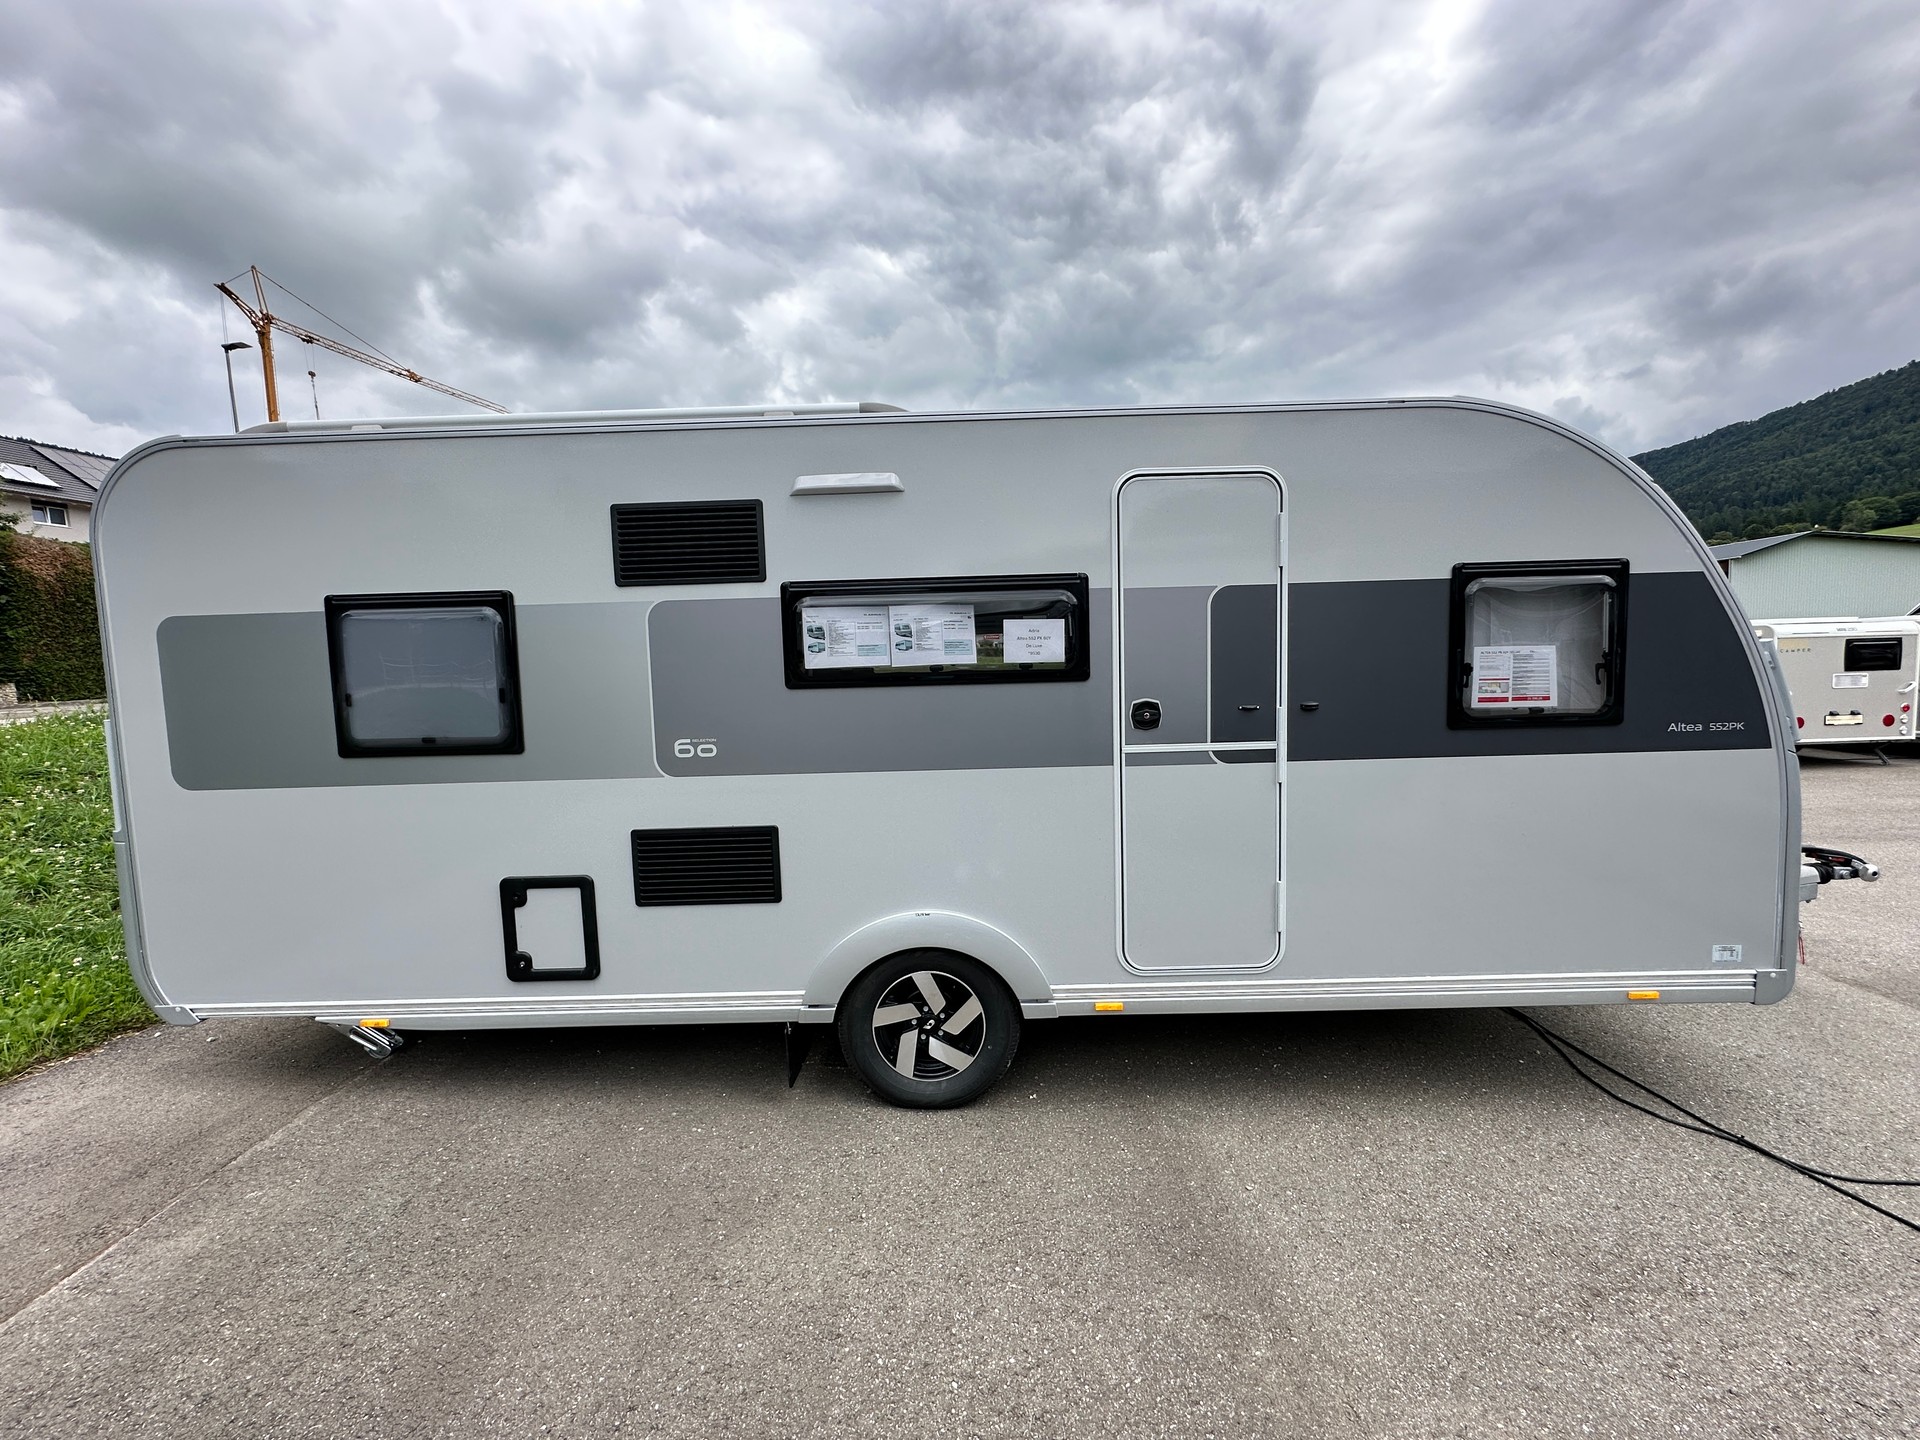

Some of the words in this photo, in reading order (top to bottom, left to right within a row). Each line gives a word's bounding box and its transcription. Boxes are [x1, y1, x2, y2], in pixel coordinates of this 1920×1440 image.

[1667, 722, 1703, 732] Altea
[1709, 722, 1745, 731] 552PK
[674, 738, 718, 758] 60
